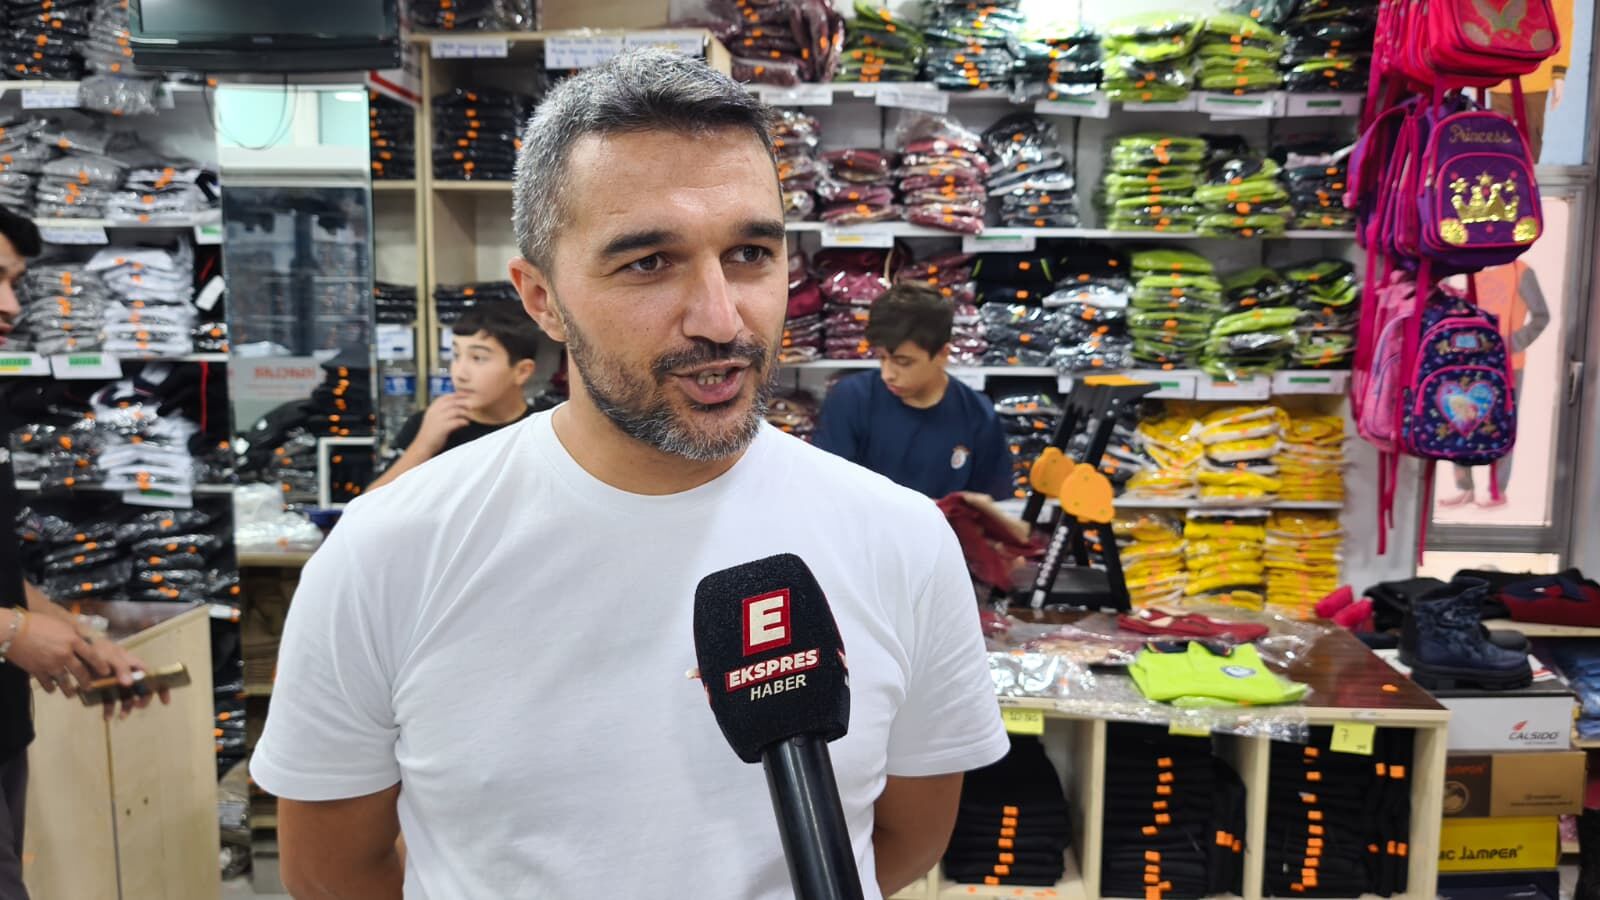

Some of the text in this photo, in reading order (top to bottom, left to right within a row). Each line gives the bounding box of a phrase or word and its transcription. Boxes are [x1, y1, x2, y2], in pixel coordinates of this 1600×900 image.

[1450, 124, 1512, 144] Princess
[749, 595, 785, 647] E
[729, 649, 818, 688] EKSPRES
[750, 674, 807, 701] HABER
[1508, 731, 1560, 741] CALSIDO
